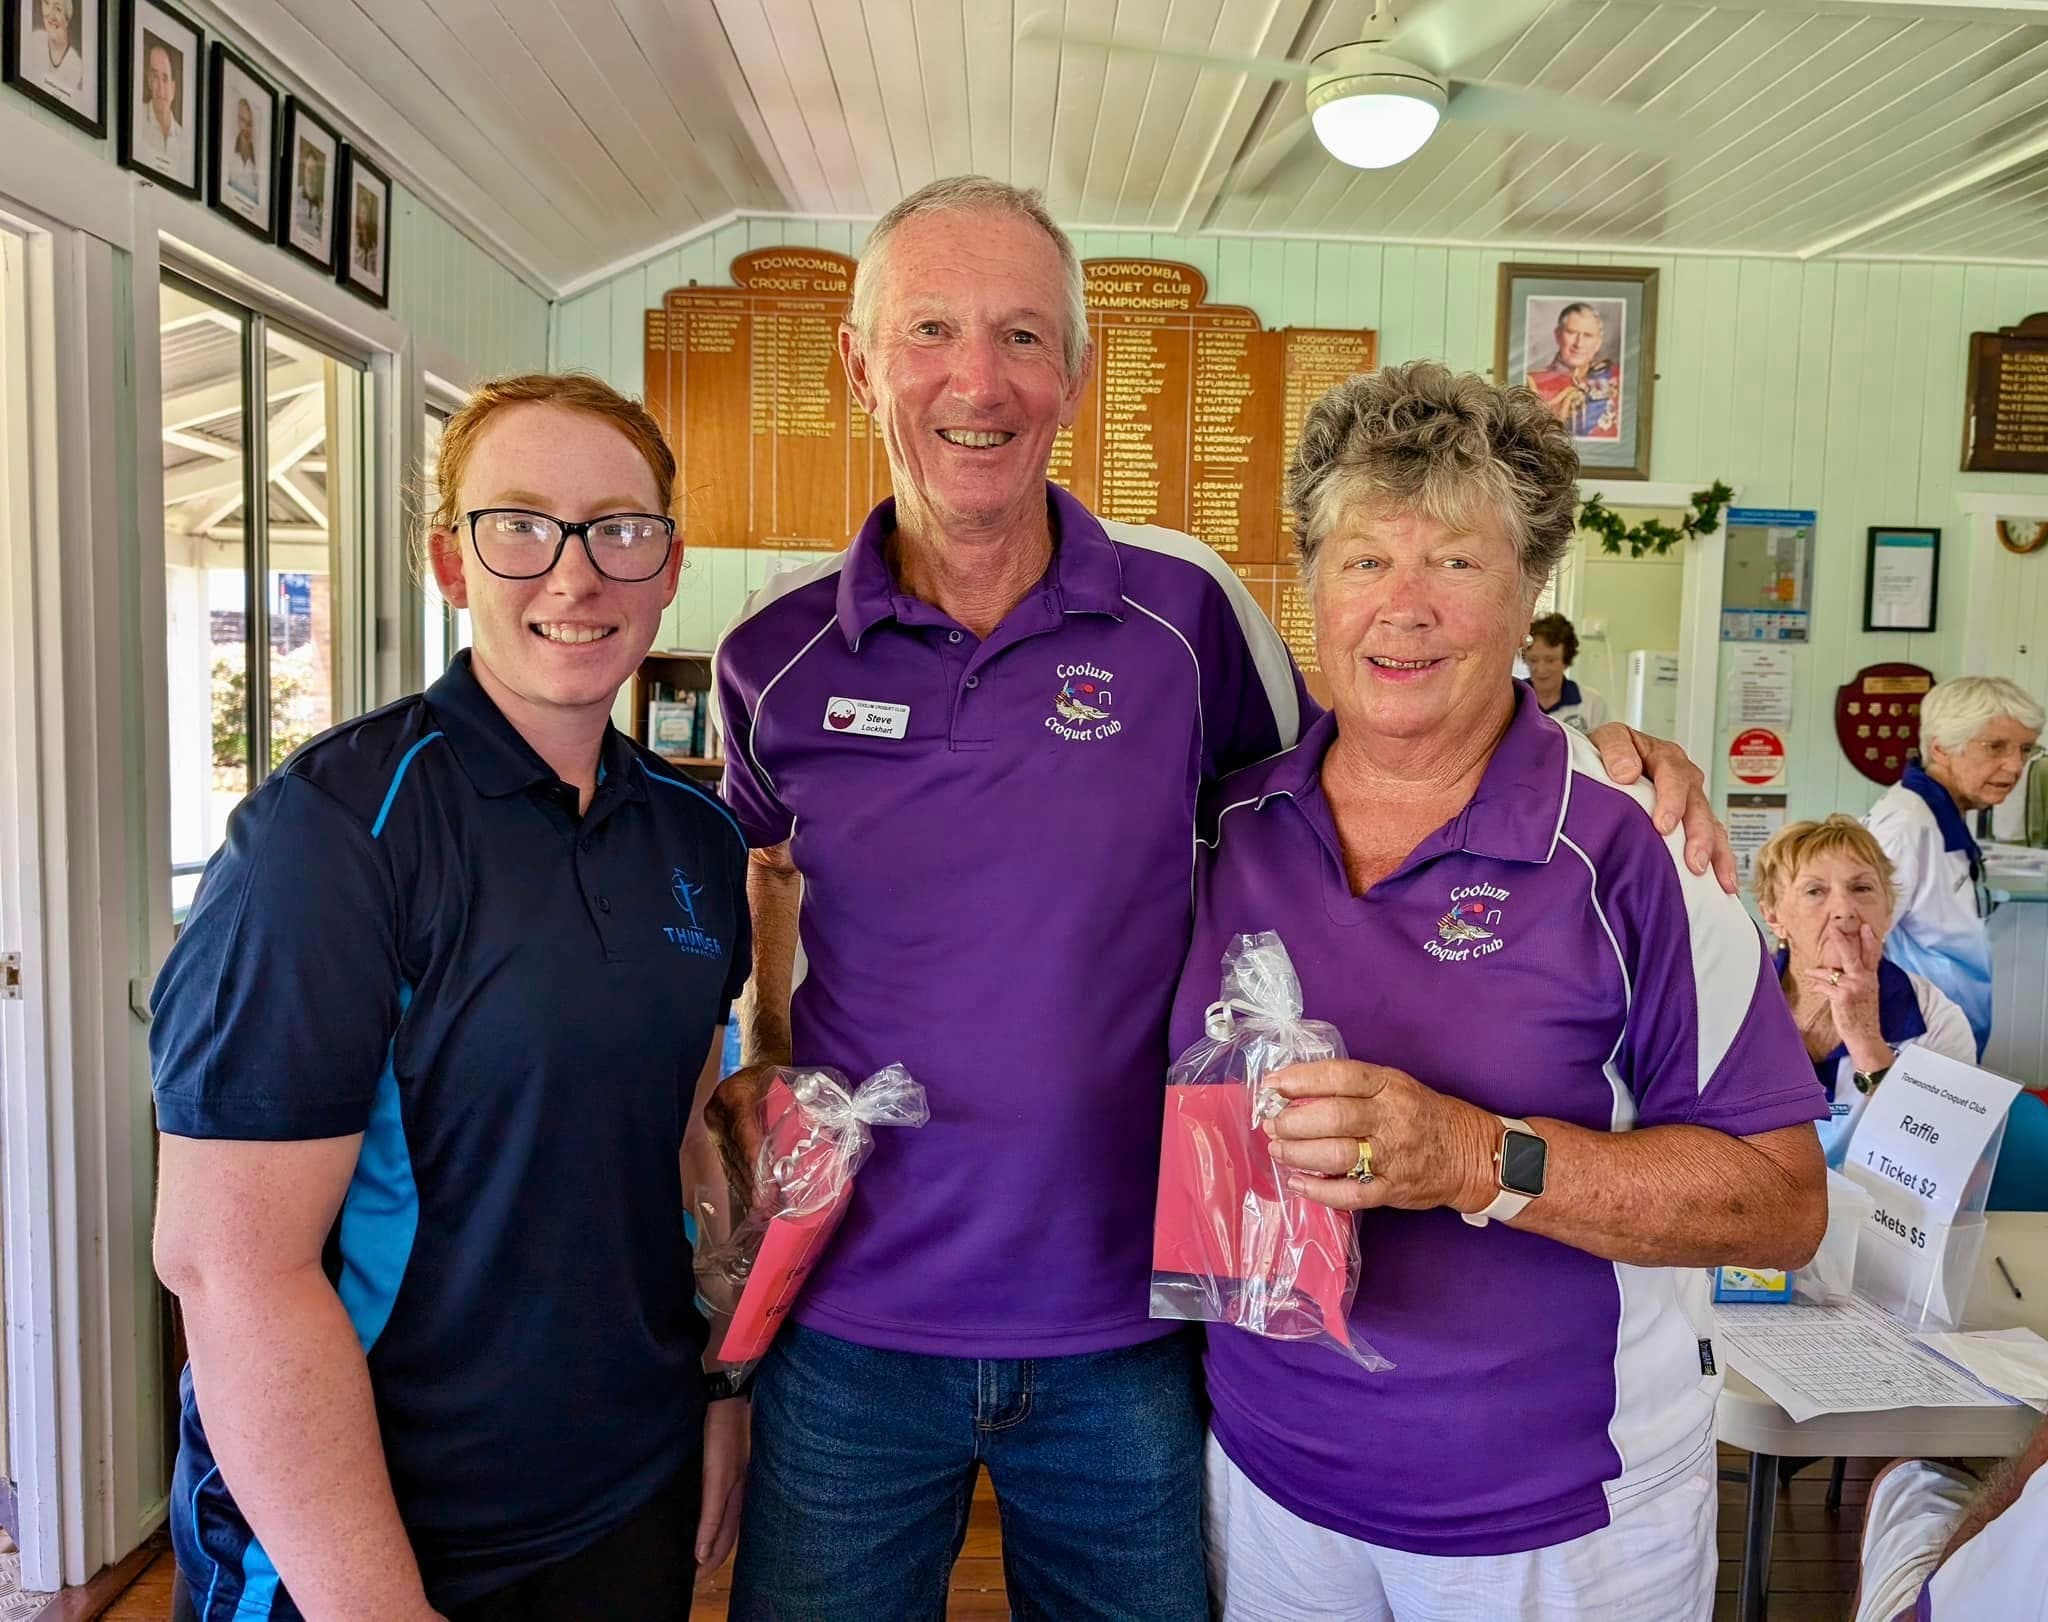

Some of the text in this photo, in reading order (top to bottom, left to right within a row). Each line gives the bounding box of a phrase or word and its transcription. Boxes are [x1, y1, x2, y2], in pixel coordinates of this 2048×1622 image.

[752, 257, 847, 276] TOOWOOMBA
[1087, 264, 1181, 281] TOOWOOMBA
[749, 277, 847, 291] CROQUET CLUB
[1083, 280, 1192, 294] ROQUET CLUB
[1287, 343, 1369, 355] CROQUET CLUB
[1296, 335, 1363, 345] TOOWOOMBA
[1057, 662, 1113, 683] Coolum
[861, 724, 893, 734] Lockhart
[866, 714, 893, 725] Steve
[1045, 717, 1121, 740] Croquet Club
[1451, 882, 1510, 901] Coolum
[1423, 939, 1504, 961] Croquet Club
[1901, 1072, 1987, 1115] Toowoomba Croquet Club
[1900, 1115, 1940, 1145] Raffle
[1867, 1151, 1938, 1200] 1 Ticket $2
[1871, 1208, 1927, 1250] ckets $5
